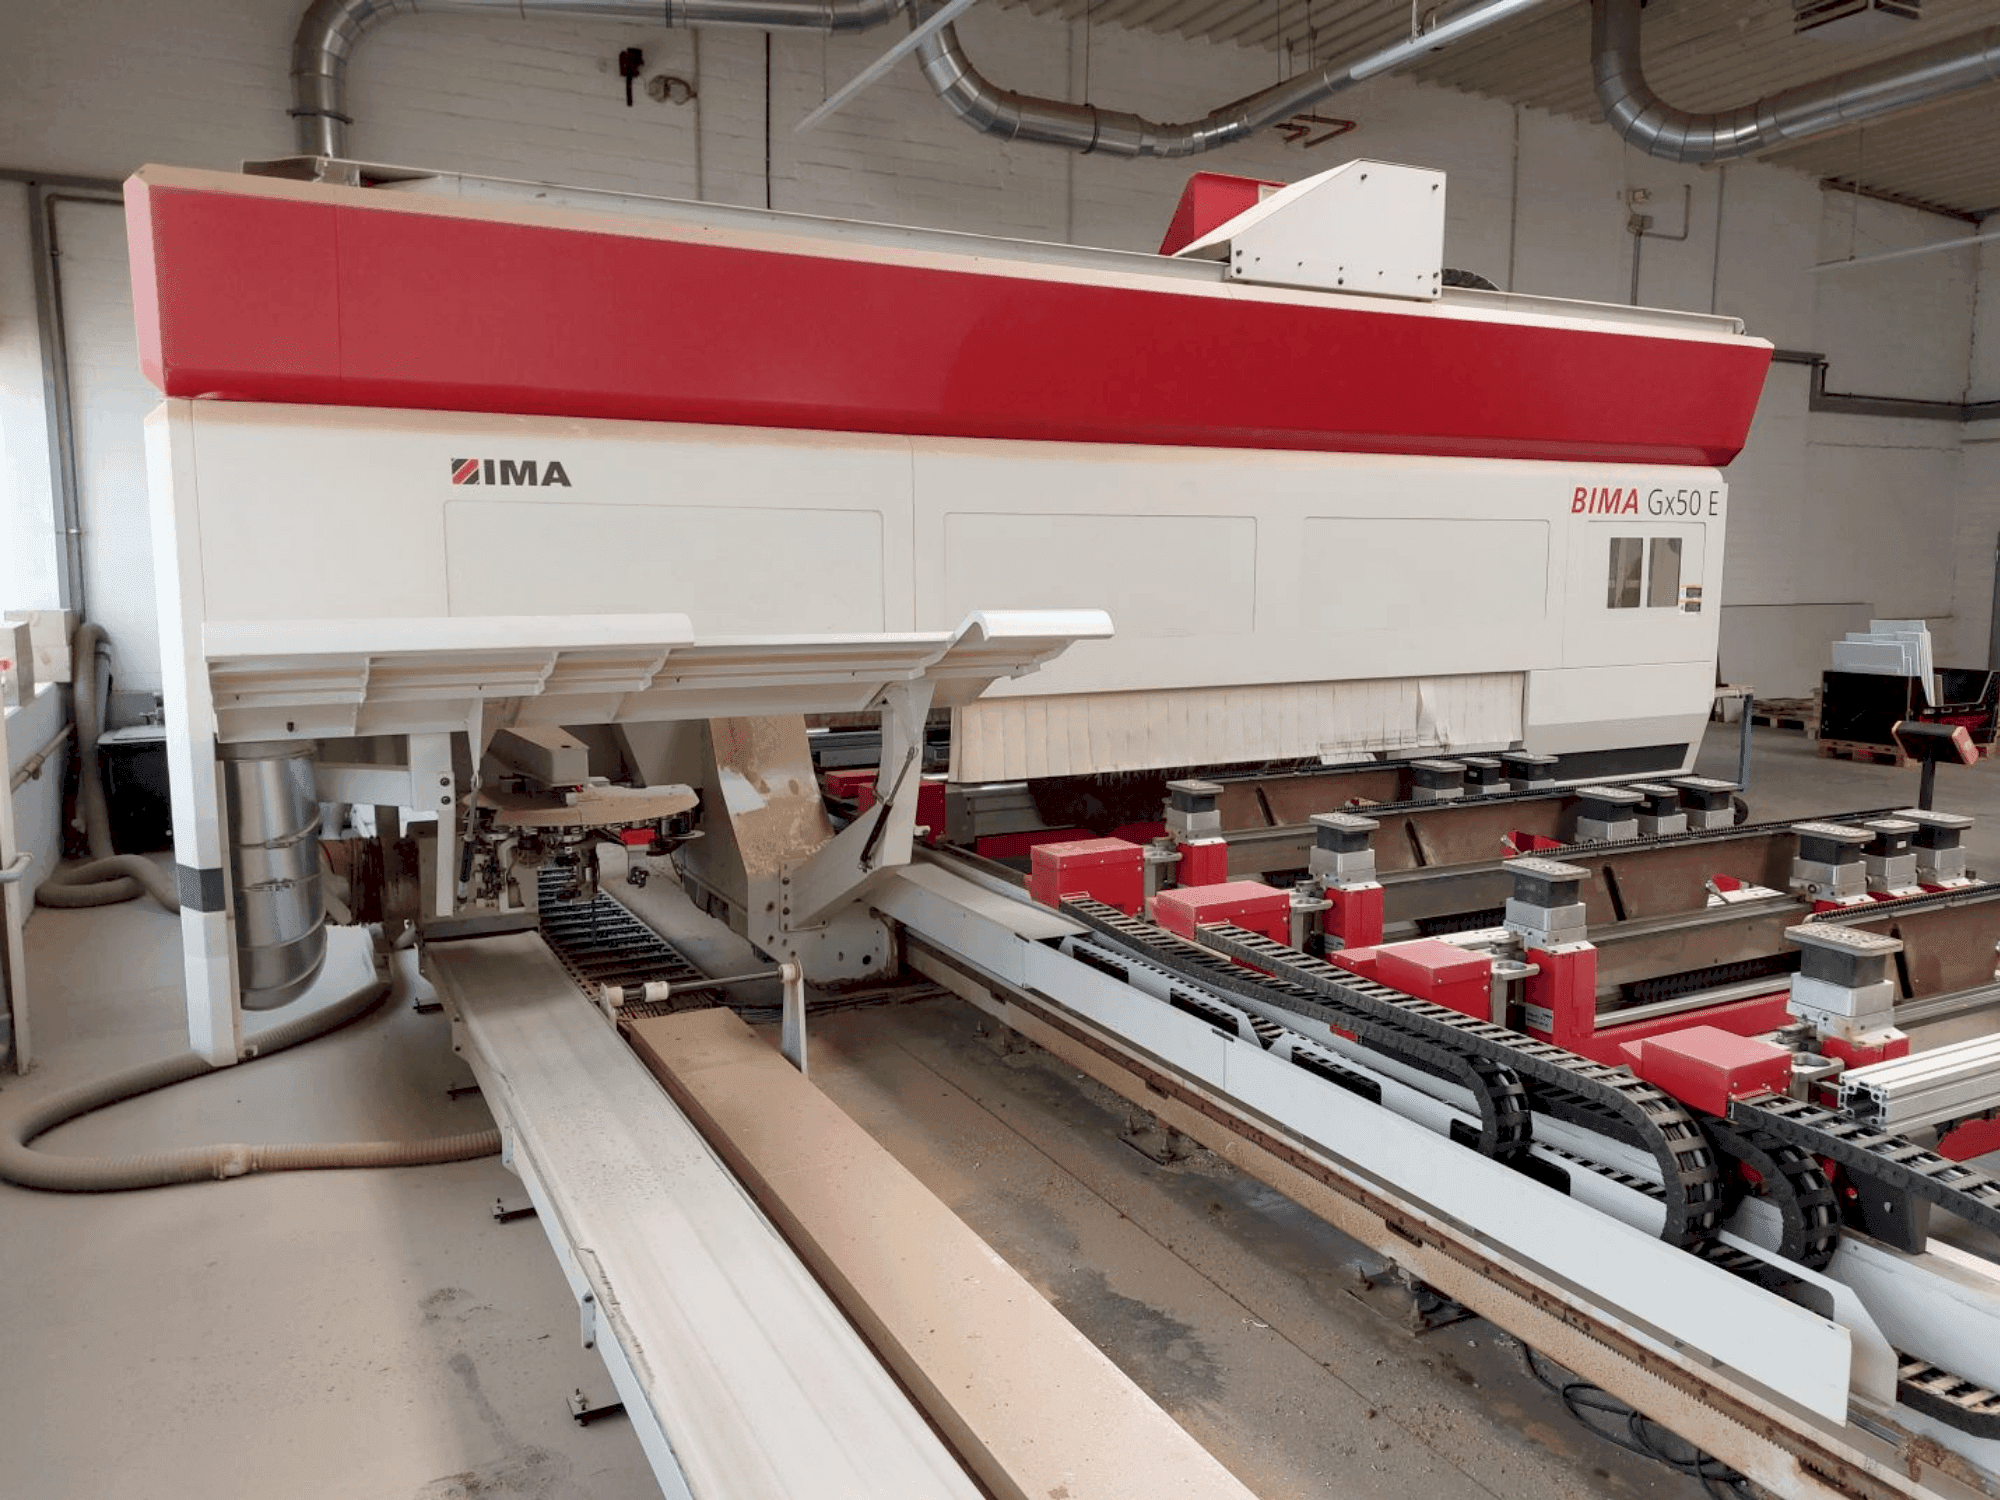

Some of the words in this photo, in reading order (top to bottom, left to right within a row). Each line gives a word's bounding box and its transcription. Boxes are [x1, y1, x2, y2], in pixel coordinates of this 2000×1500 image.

[484, 459, 572, 487] IMA
[1571, 487, 1639, 514] BIMA
[1648, 488, 1701, 516] Gx50
[1708, 490, 1719, 516] E
